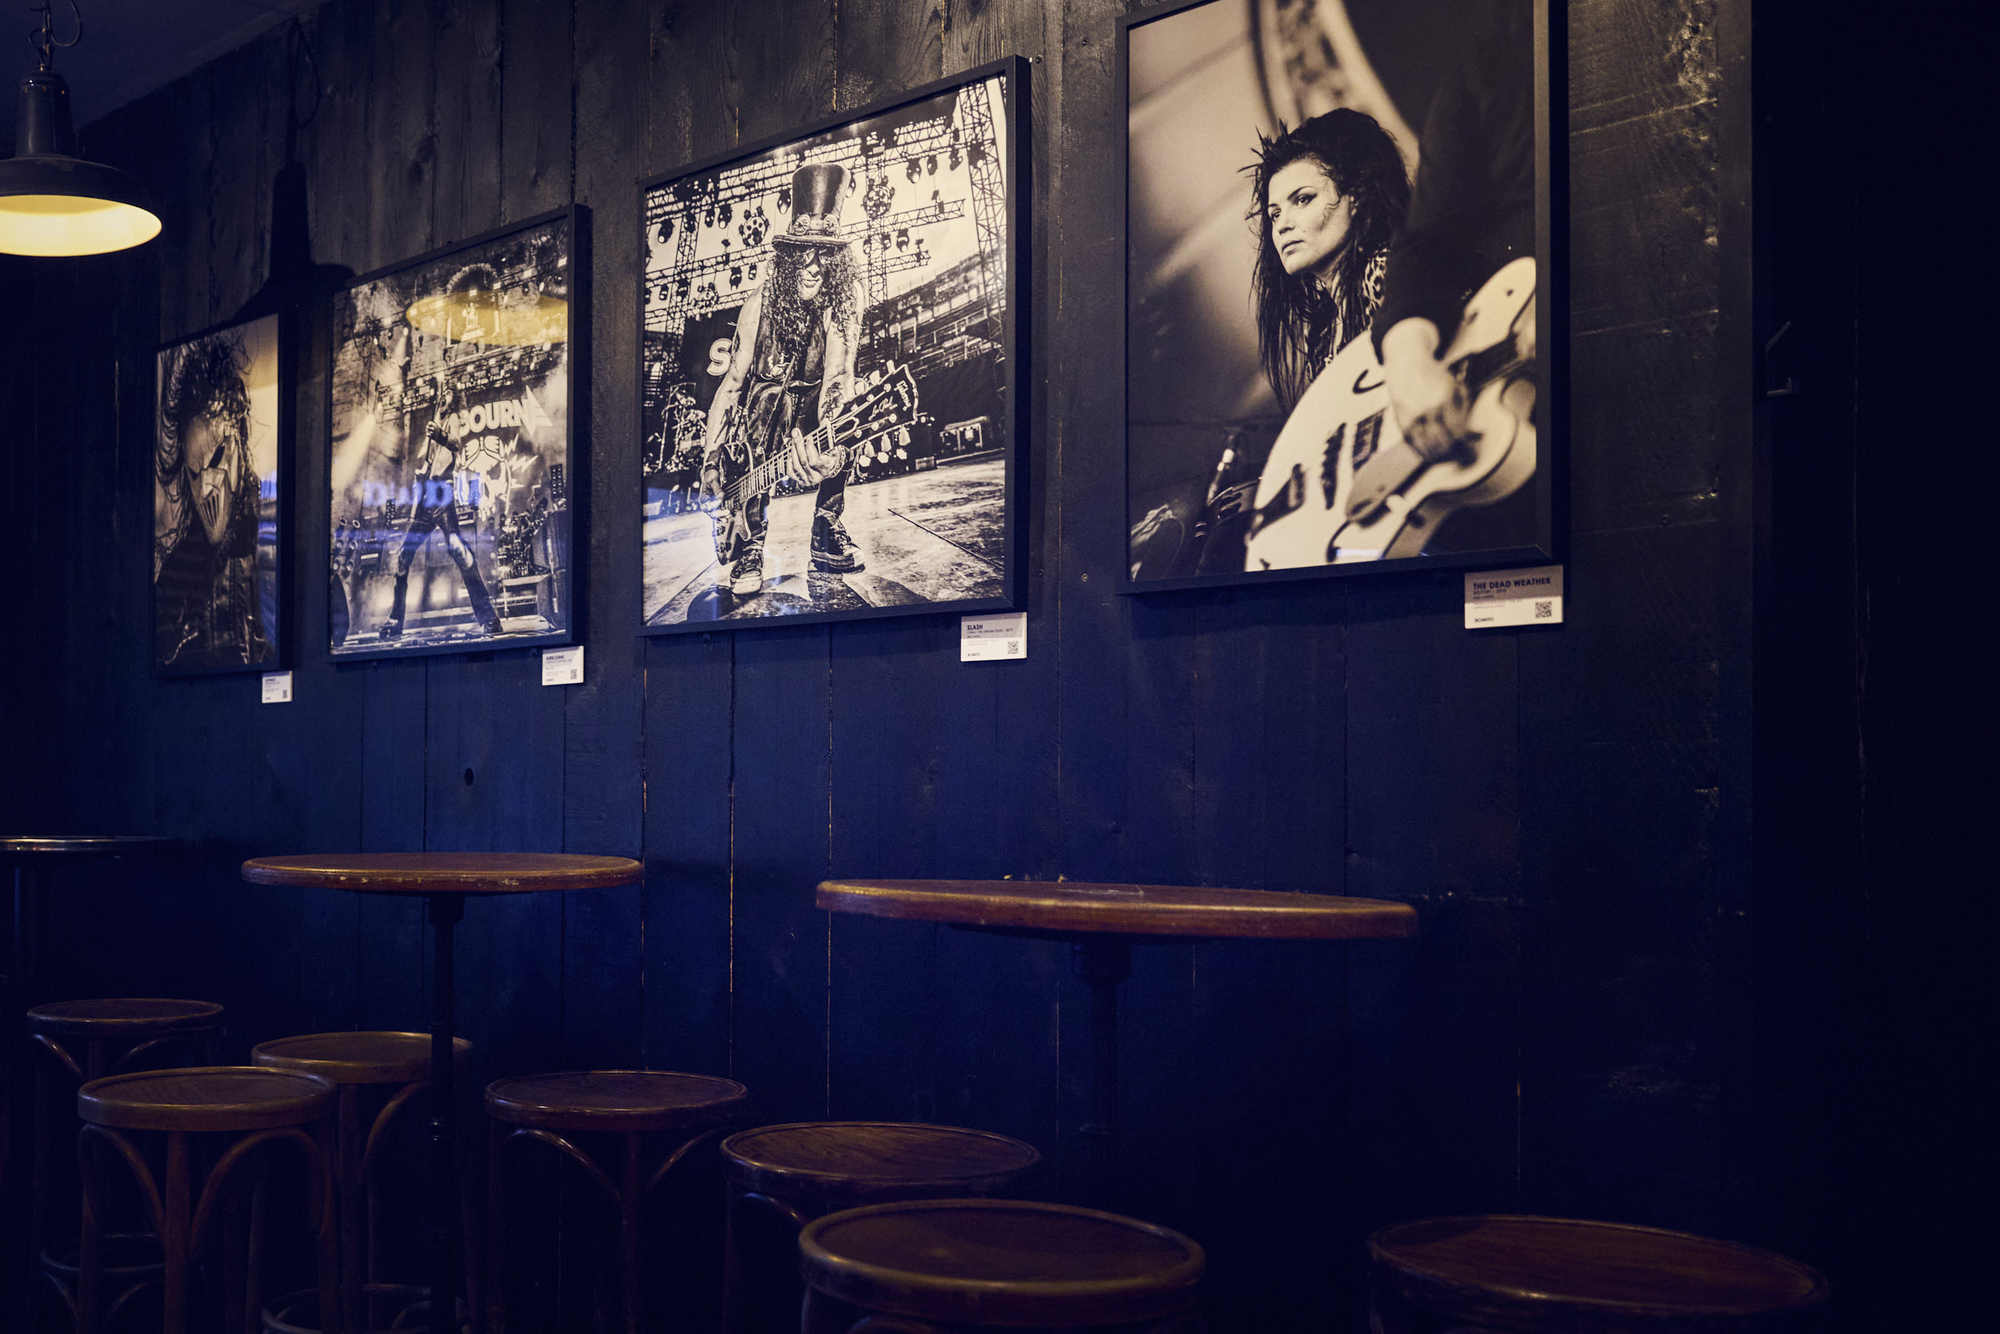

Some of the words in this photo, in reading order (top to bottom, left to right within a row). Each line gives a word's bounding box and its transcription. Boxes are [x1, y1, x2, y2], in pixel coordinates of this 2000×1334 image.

[1473, 581, 1487, 590] THE
[1489, 579, 1512, 589] DEAD
[1513, 576, 1552, 587] WEATHER
